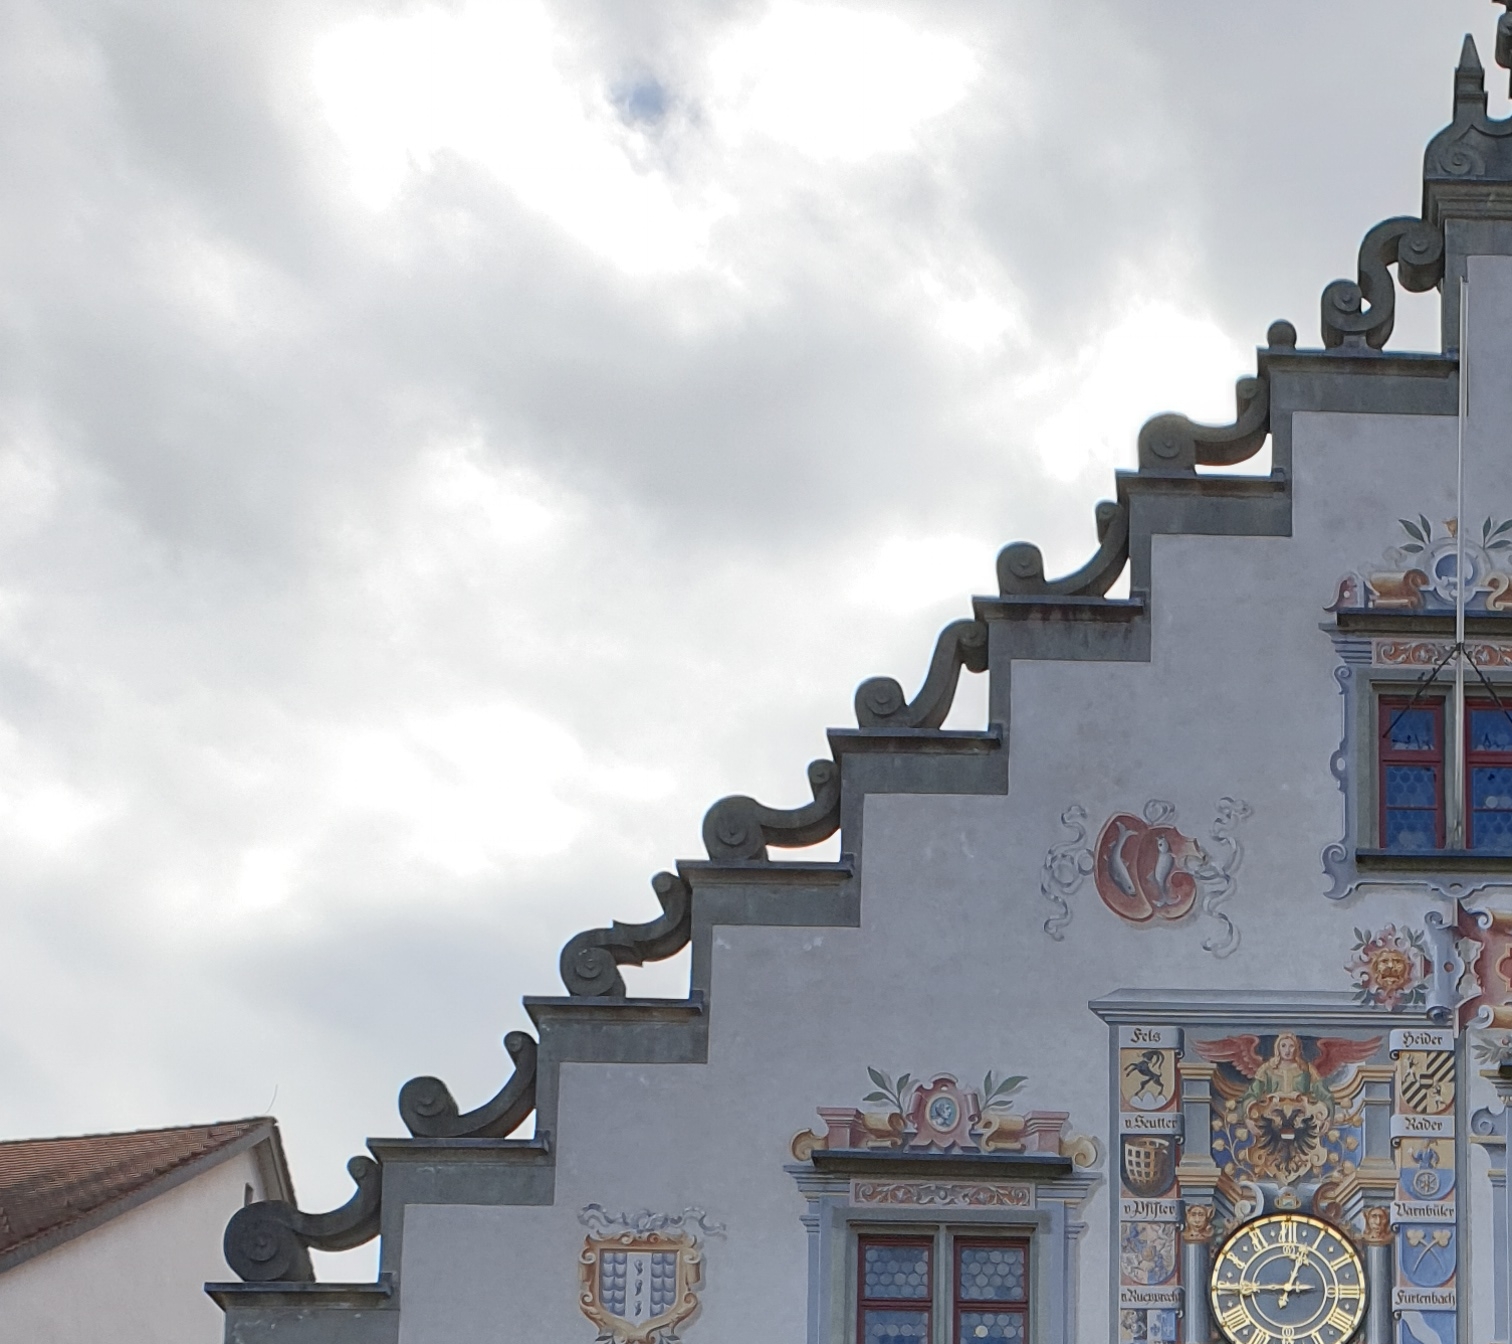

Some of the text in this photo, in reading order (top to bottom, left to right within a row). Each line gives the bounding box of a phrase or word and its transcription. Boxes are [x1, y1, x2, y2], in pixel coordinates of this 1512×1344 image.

[1130, 1028, 1162, 1044] Fels
[1402, 1032, 1443, 1048] Heider
[1394, 1290, 1456, 1306] Furtenbach
